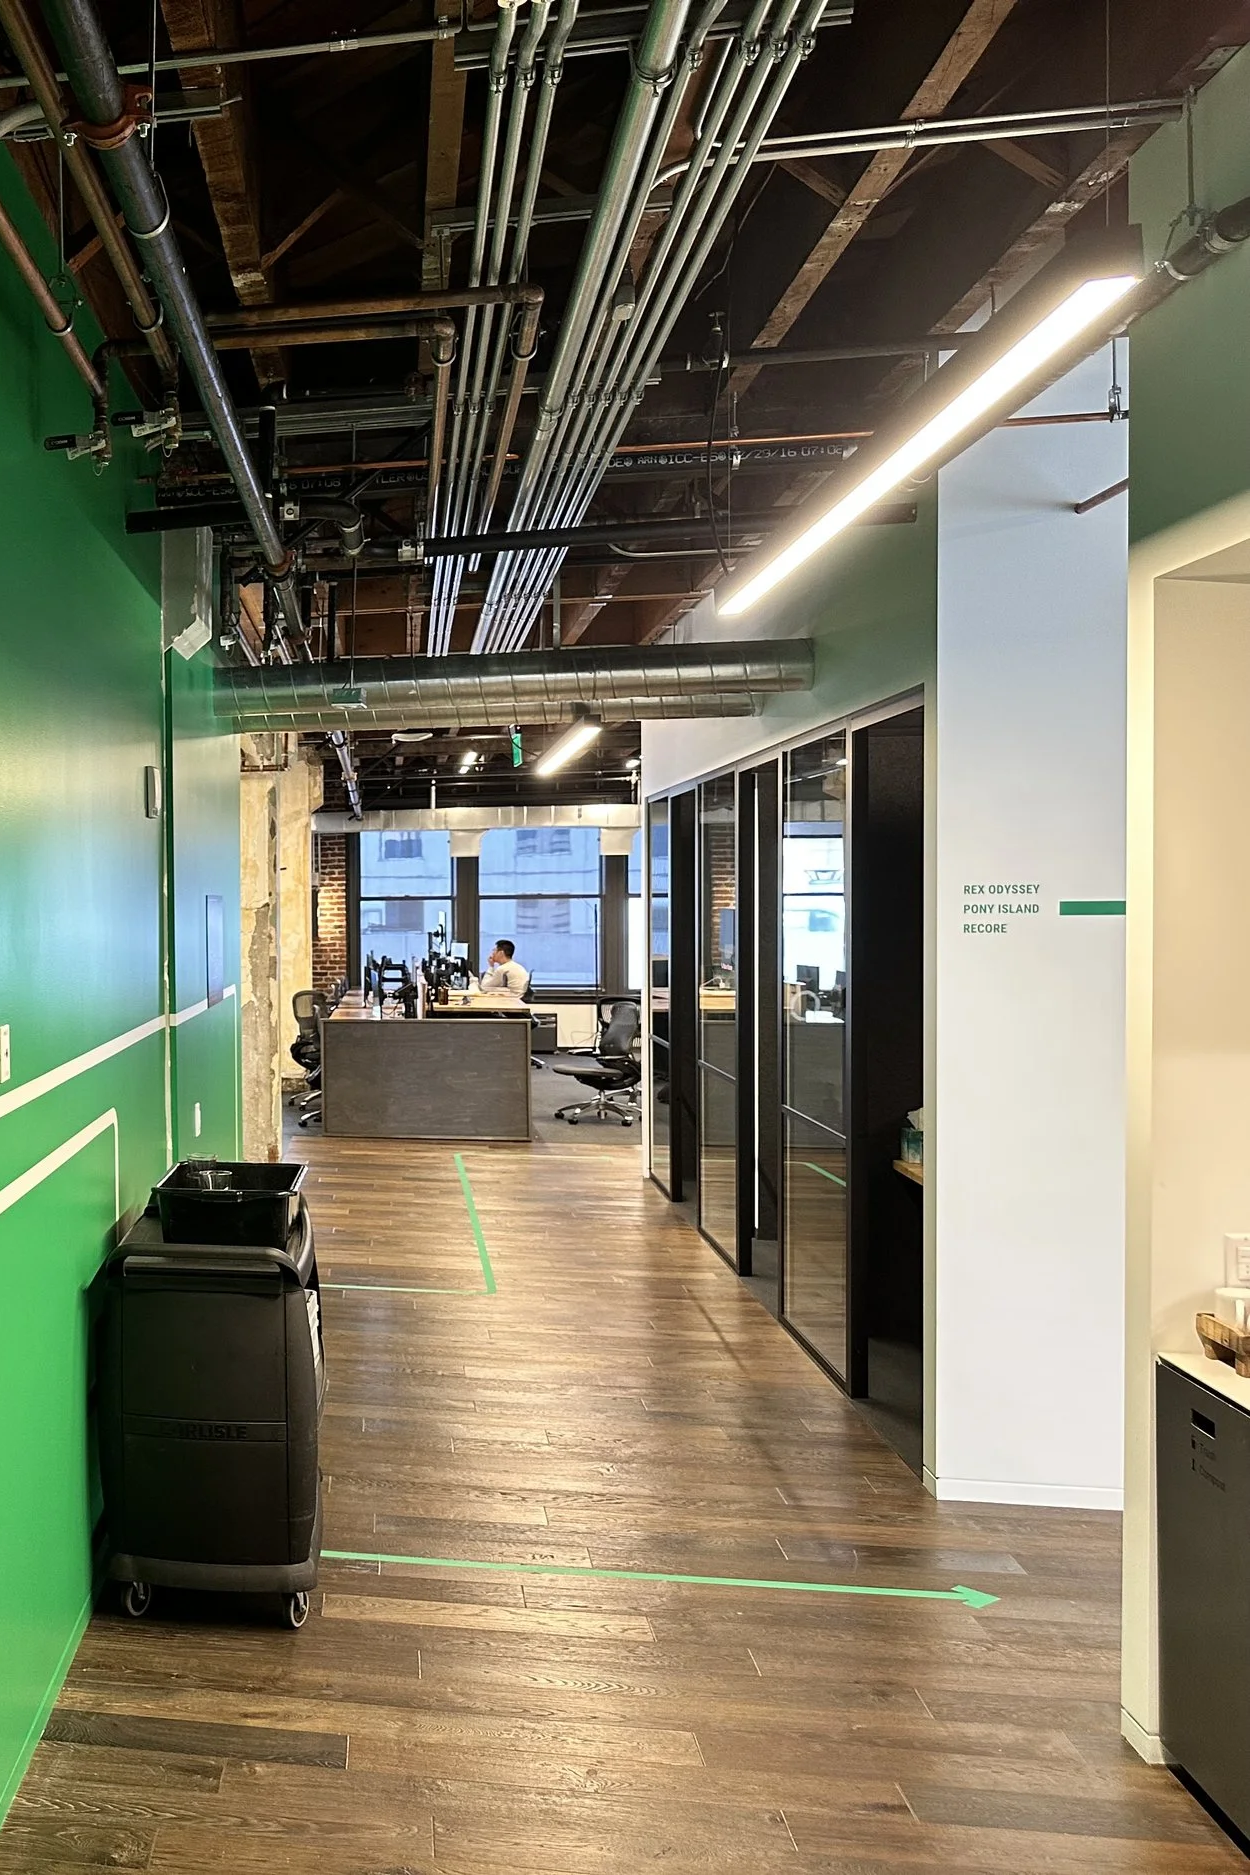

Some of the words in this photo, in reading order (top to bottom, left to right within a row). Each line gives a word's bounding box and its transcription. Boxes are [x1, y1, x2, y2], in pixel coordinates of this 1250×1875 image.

[963, 885, 985, 895] REX
[988, 884, 1040, 895] ODYSSEY
[963, 904, 995, 914] PONY
[998, 903, 1040, 914] ISLAND
[963, 923, 1007, 934] RECORE
